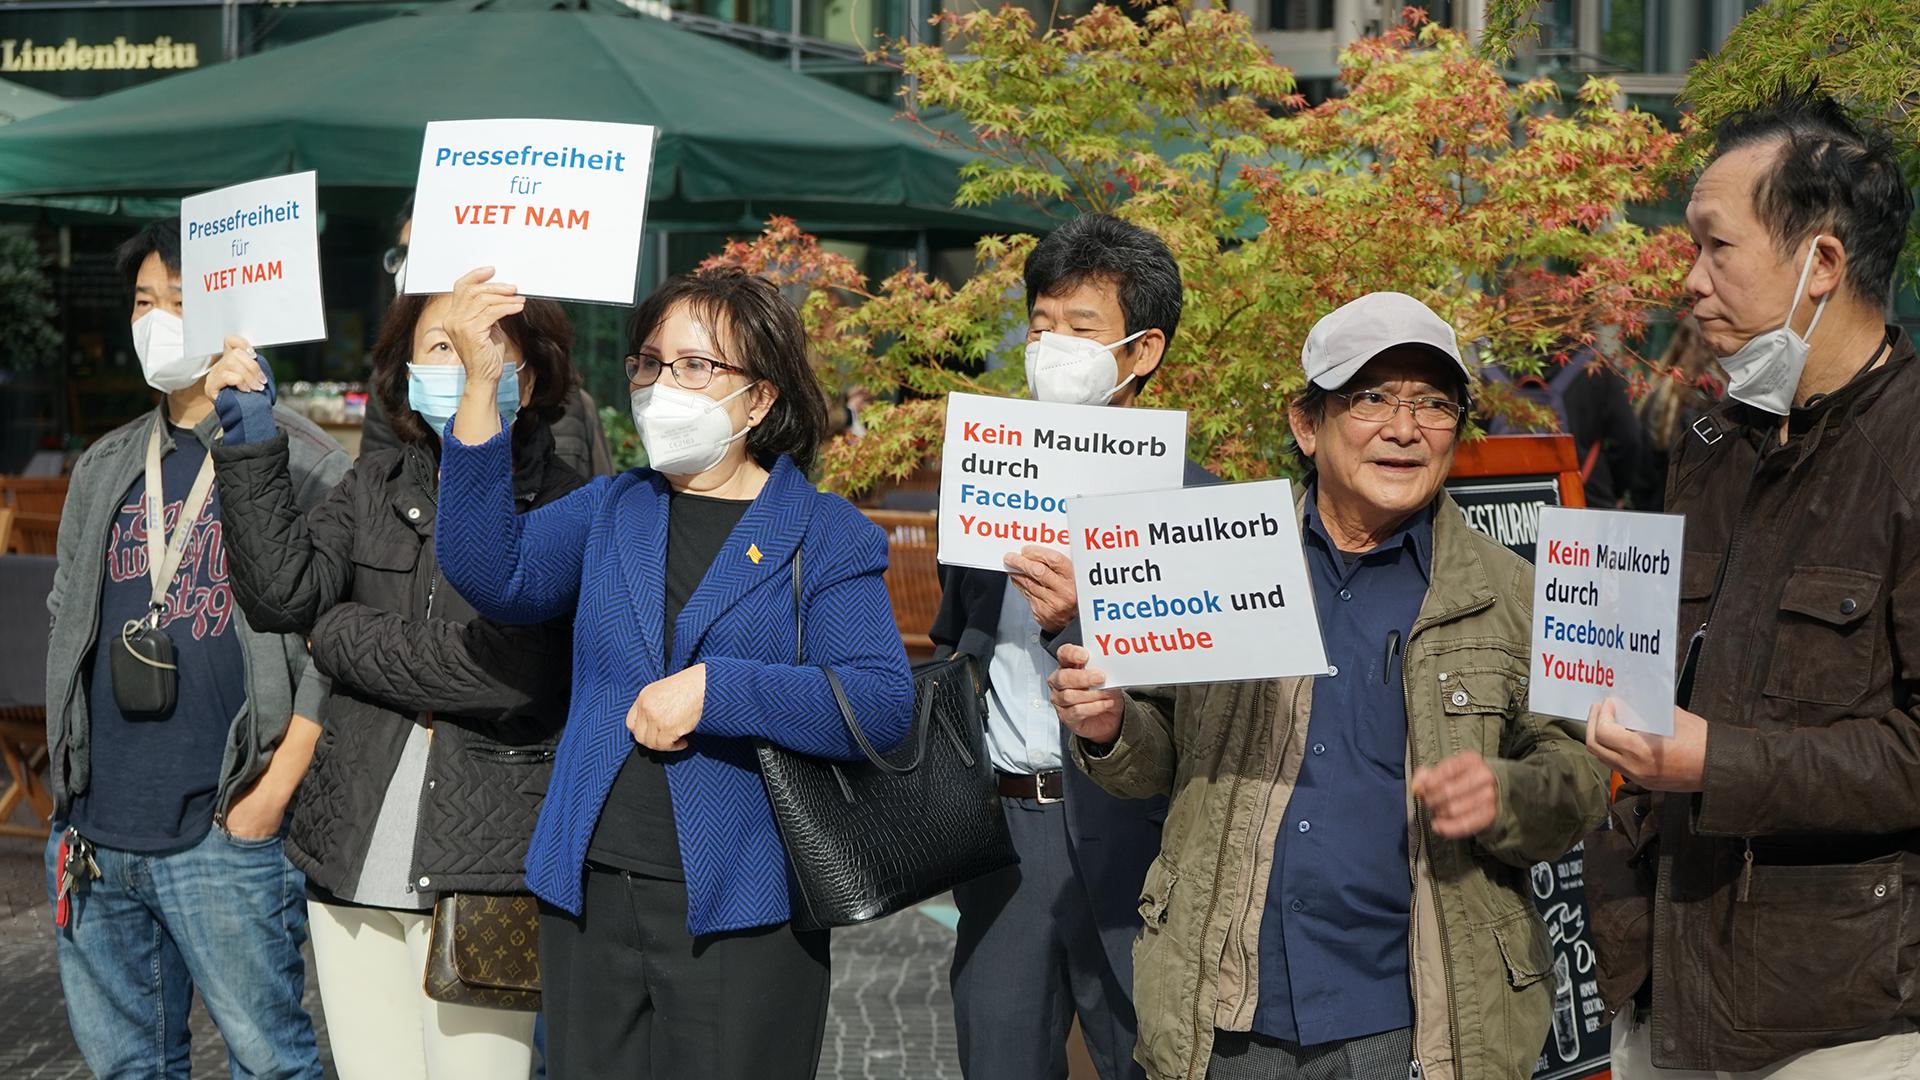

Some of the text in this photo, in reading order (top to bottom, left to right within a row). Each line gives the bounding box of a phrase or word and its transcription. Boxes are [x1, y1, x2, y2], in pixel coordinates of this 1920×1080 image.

[1, 36, 198, 71] Lindenbräu
[436, 146, 625, 172] Pressefreiheit
[510, 175, 542, 195] für
[189, 201, 300, 241] Pressefreiheit
[455, 205, 590, 230] VIET NAM
[231, 239, 250, 258] für
[203, 260, 283, 292] VIET NAM
[964, 421, 1167, 457] Kein Maulkorb
[961, 453, 1039, 479] durch
[959, 515, 1070, 545] Youtube
[1084, 513, 1279, 550] Kein Maulkorb
[1088, 559, 1162, 586] durch
[1548, 540, 1670, 576] Kein Maulkorb
[1092, 584, 1286, 621] Facebook und
[1545, 577, 1599, 607] durch
[1094, 628, 1214, 656] Youtube
[1544, 615, 1661, 655] Facebook und
[1541, 652, 1615, 688] Youtube
